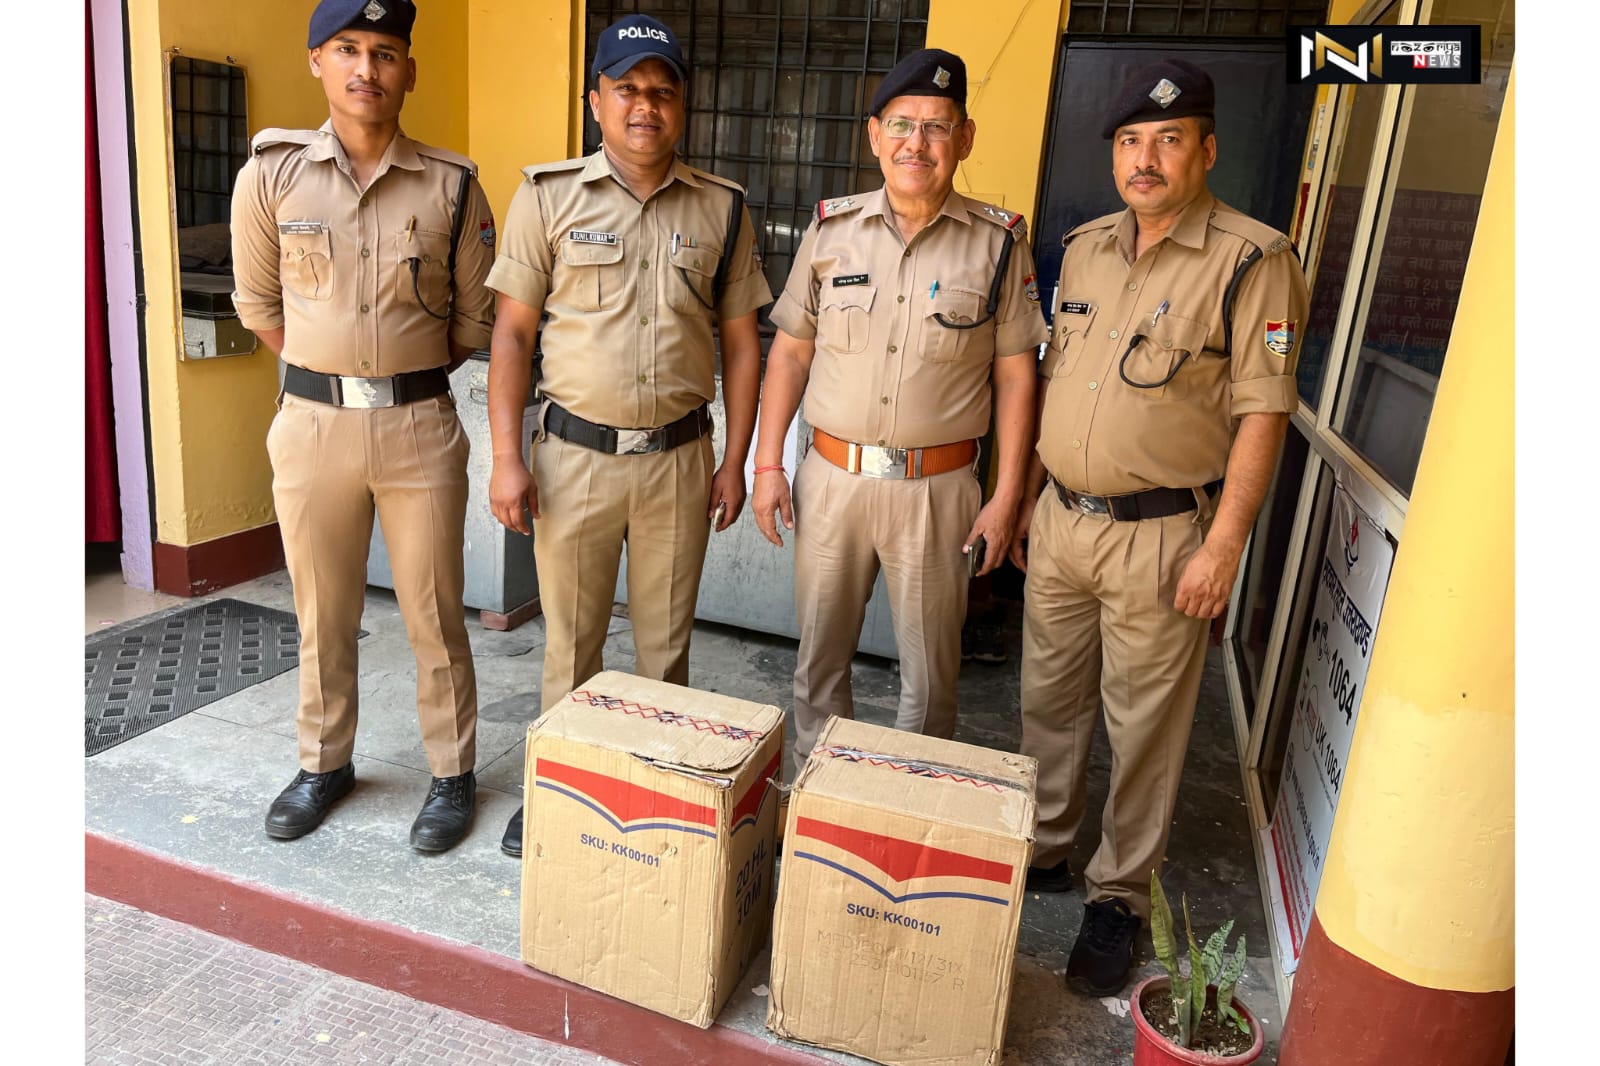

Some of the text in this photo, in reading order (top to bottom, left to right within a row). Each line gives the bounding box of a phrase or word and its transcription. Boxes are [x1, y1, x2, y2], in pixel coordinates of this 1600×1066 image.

[618, 26, 669, 43] POLICE
[1328, 649, 1357, 726] 1064
[1316, 716, 1327, 756] UK
[1324, 742, 1342, 794] 1064
[580, 833, 660, 868] SKU: KK00101
[847, 903, 941, 937] SKU: KK00101
